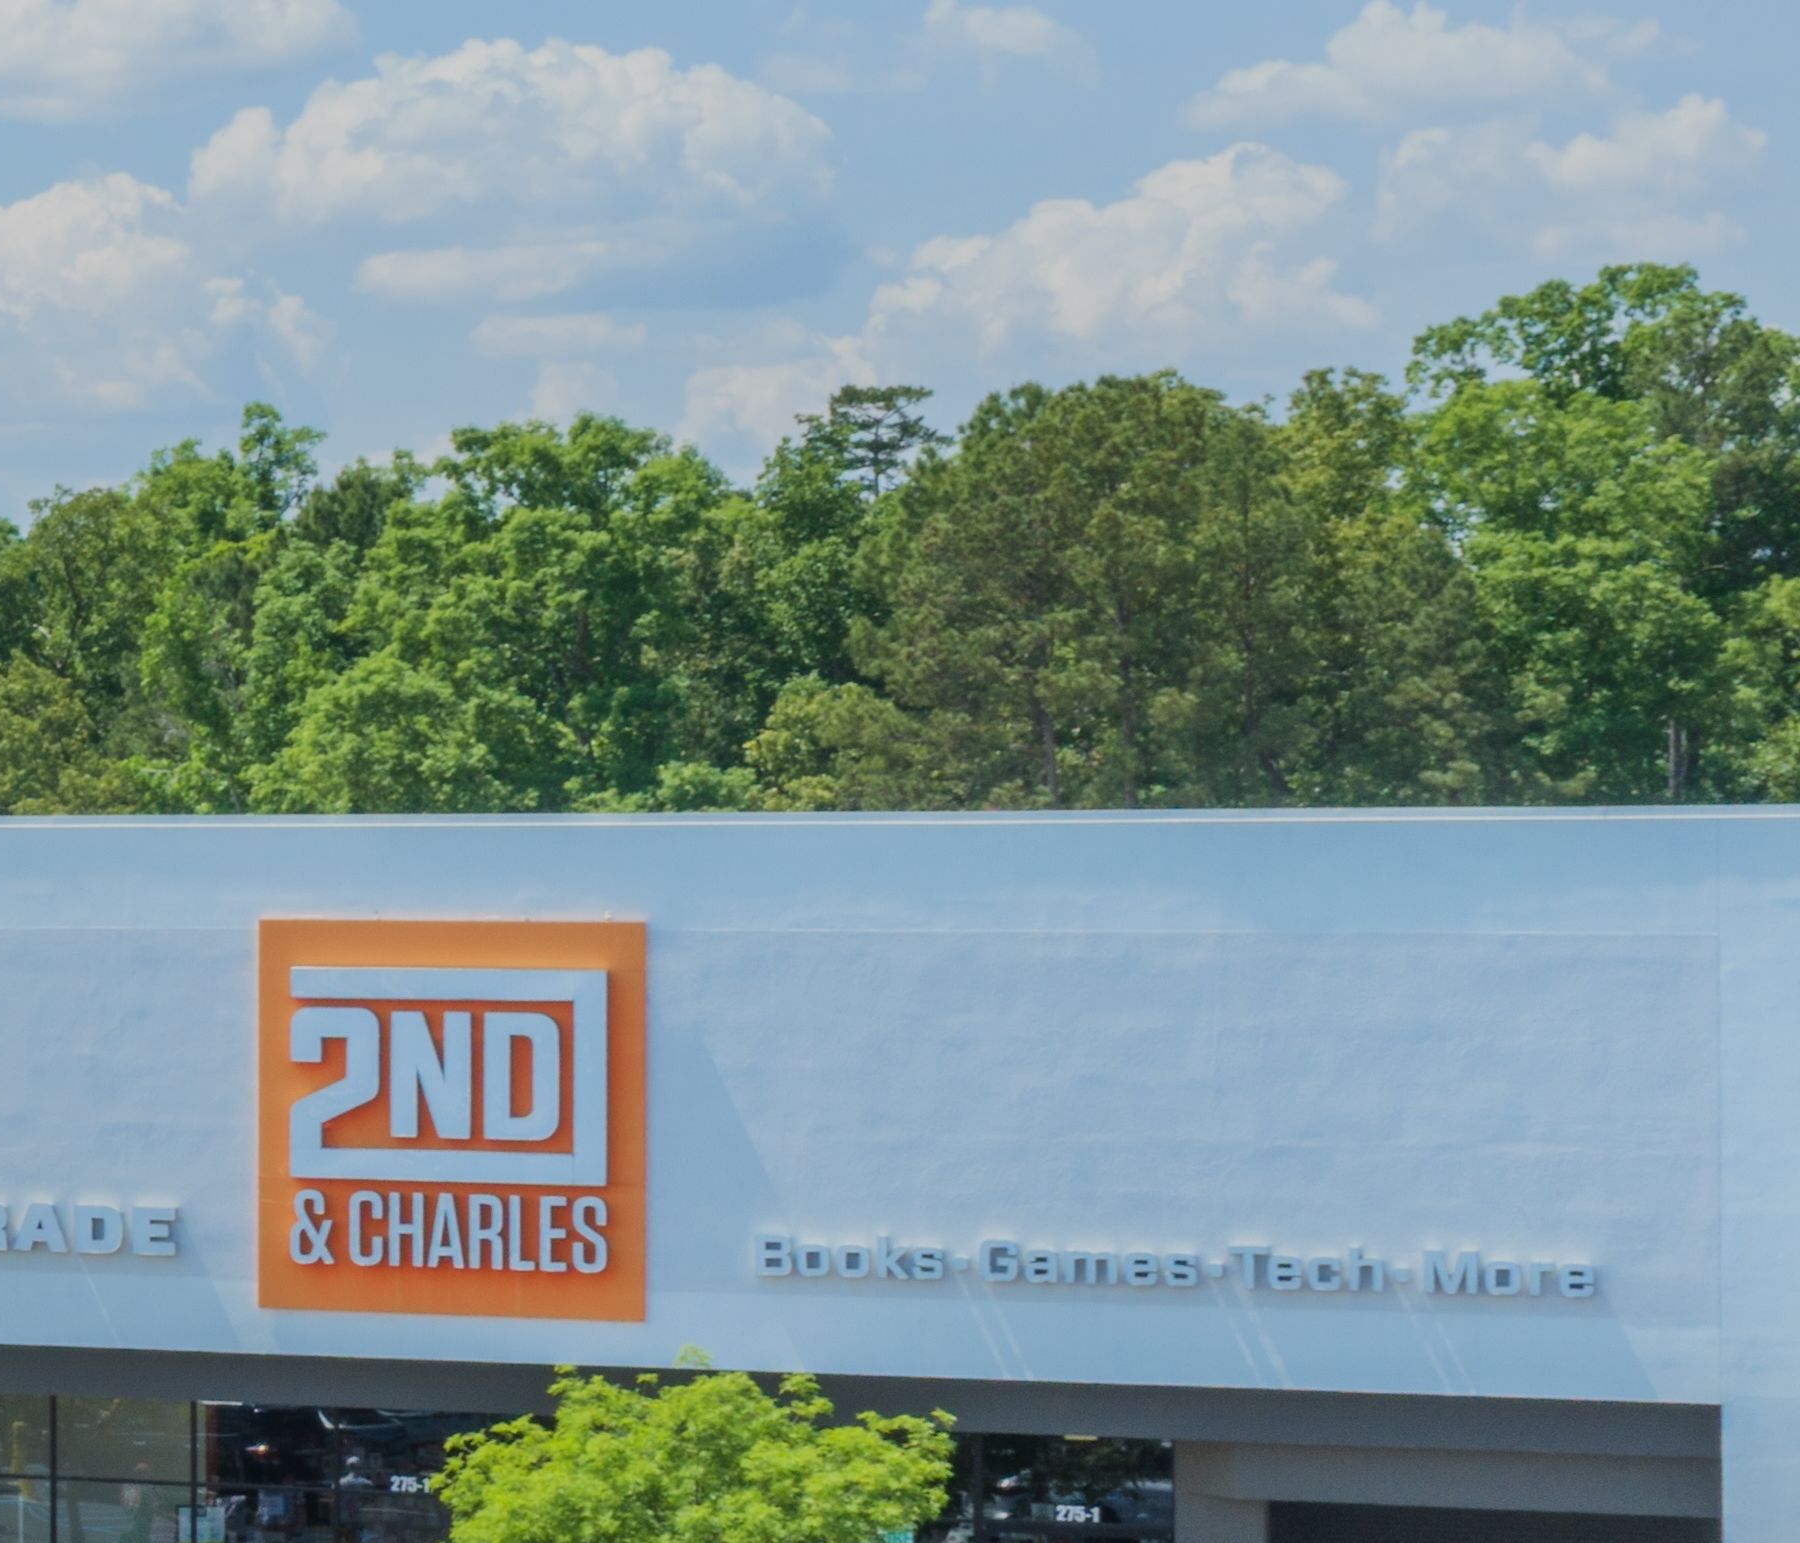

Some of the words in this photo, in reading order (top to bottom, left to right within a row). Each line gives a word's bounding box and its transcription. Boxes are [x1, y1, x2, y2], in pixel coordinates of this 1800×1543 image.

[290, 1006, 560, 1178] 2ND
[290, 1189, 334, 1264] &
[348, 1190, 607, 1273] CHARLES
[1056, 1504, 1101, 1523] 275-1
